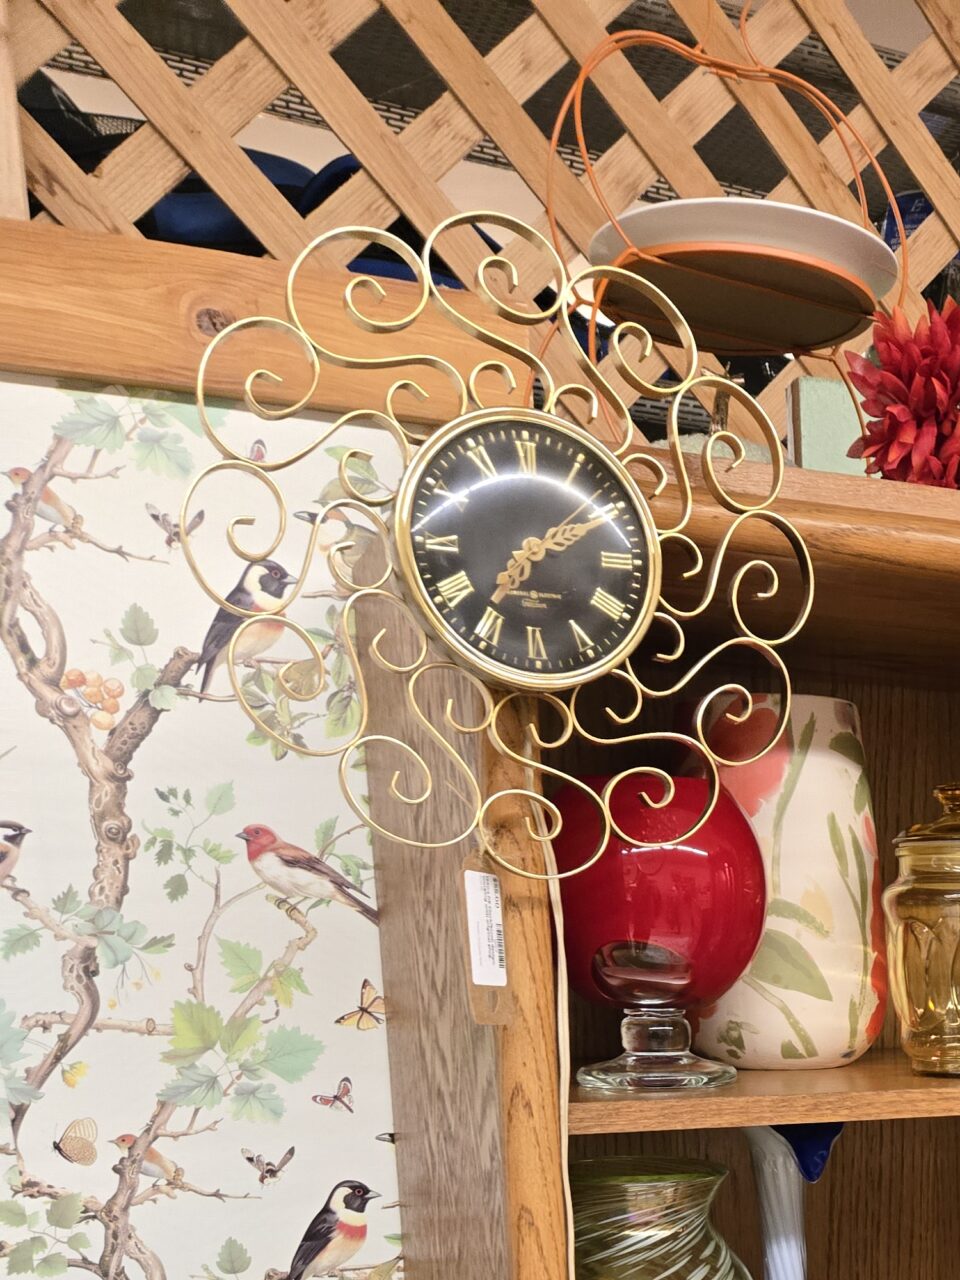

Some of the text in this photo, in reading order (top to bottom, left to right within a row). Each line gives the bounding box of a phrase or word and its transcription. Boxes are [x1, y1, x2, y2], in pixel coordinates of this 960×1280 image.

[467, 444, 499, 479] XI
[515, 440, 537, 477] XII
[432, 479, 470, 513] X
[424, 531, 460, 554] IX
[600, 551, 633, 570] III
[436, 570, 476, 609] VIII
[590, 587, 626, 622] IIII
[474, 606, 506, 647] VII
[526, 625, 548, 660] VI
[568, 619, 595, 653] V
